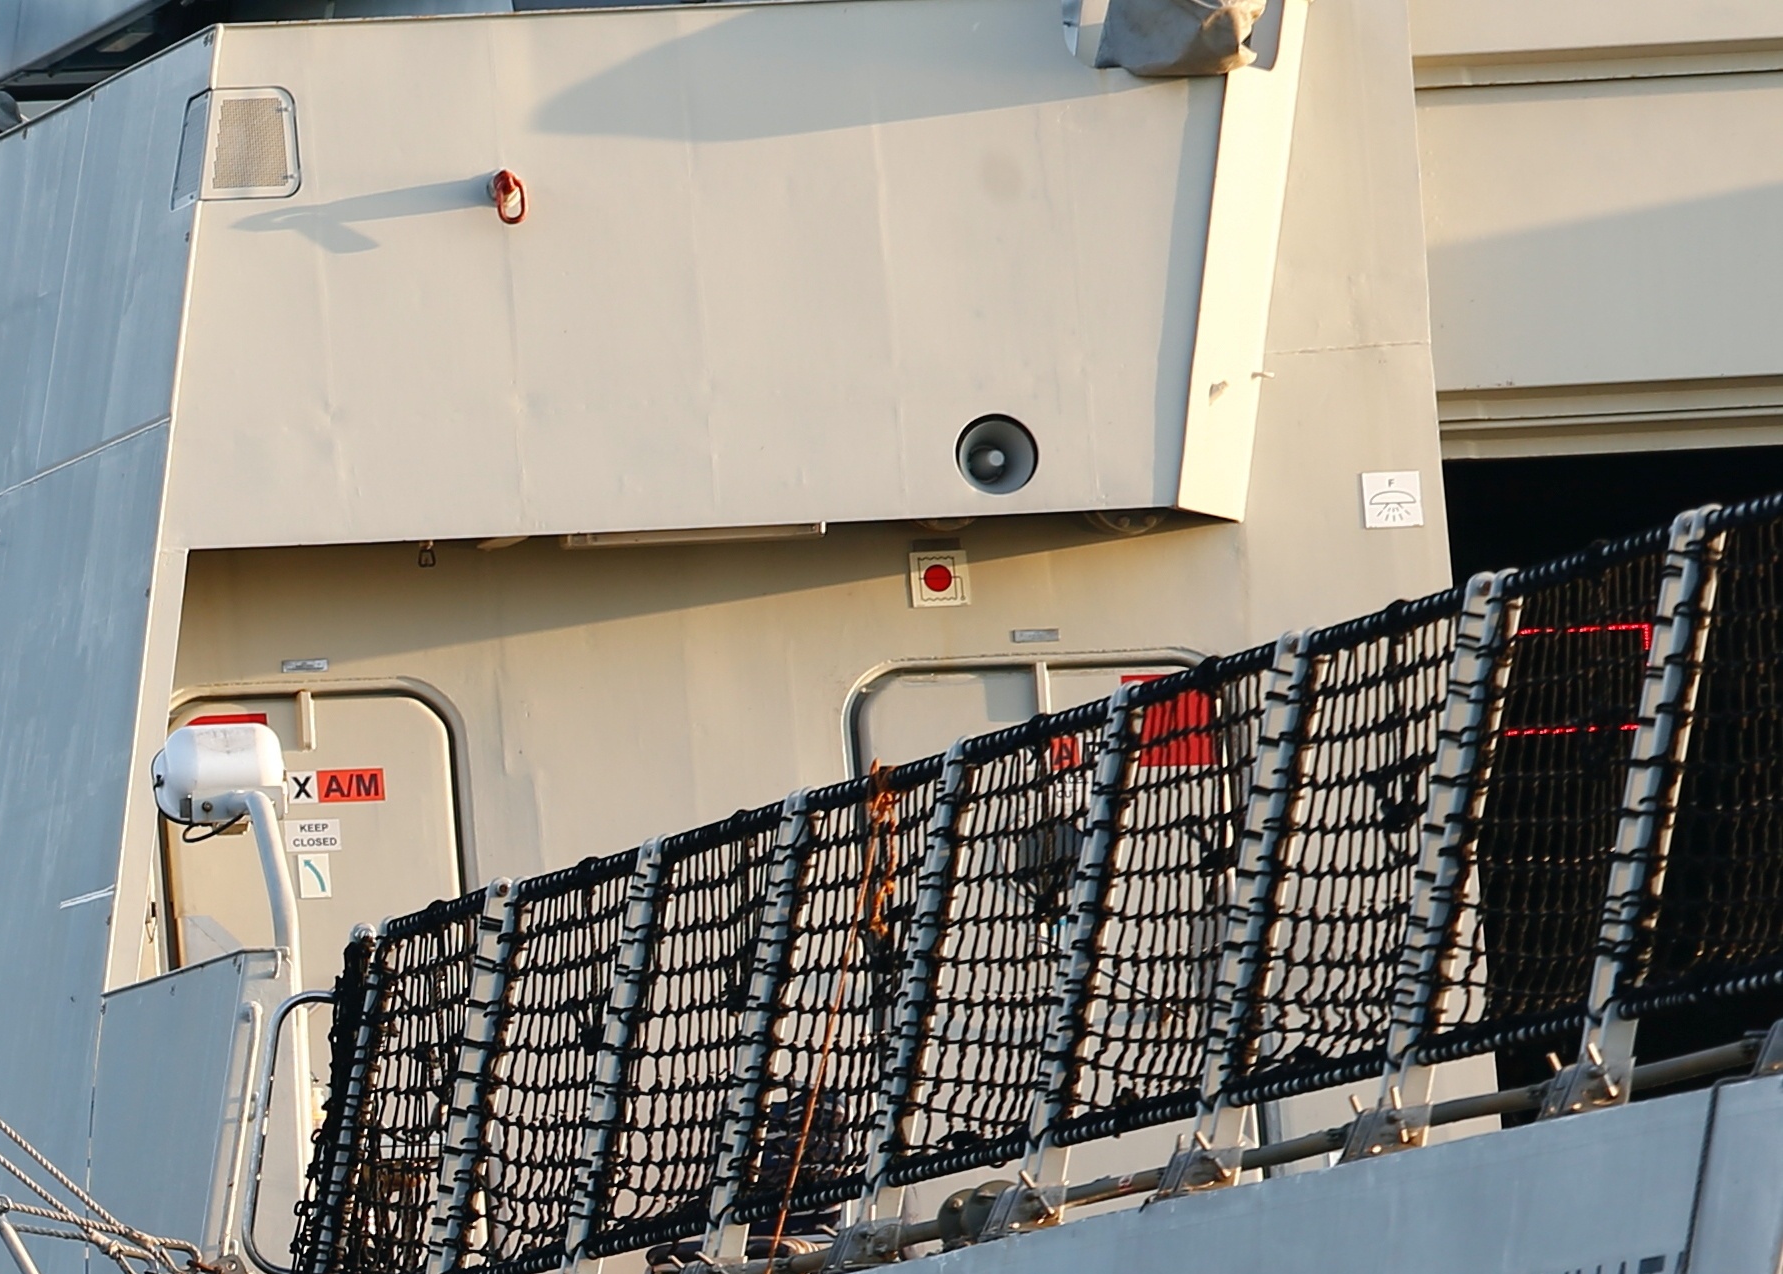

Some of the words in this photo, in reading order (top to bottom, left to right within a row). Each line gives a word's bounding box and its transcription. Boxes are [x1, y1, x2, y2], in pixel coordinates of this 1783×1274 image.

[1388, 478, 1395, 487] F
[291, 775, 313, 799] X
[324, 773, 379, 798] A/M
[299, 823, 329, 833] KEEP
[292, 837, 338, 848] CLOSED
